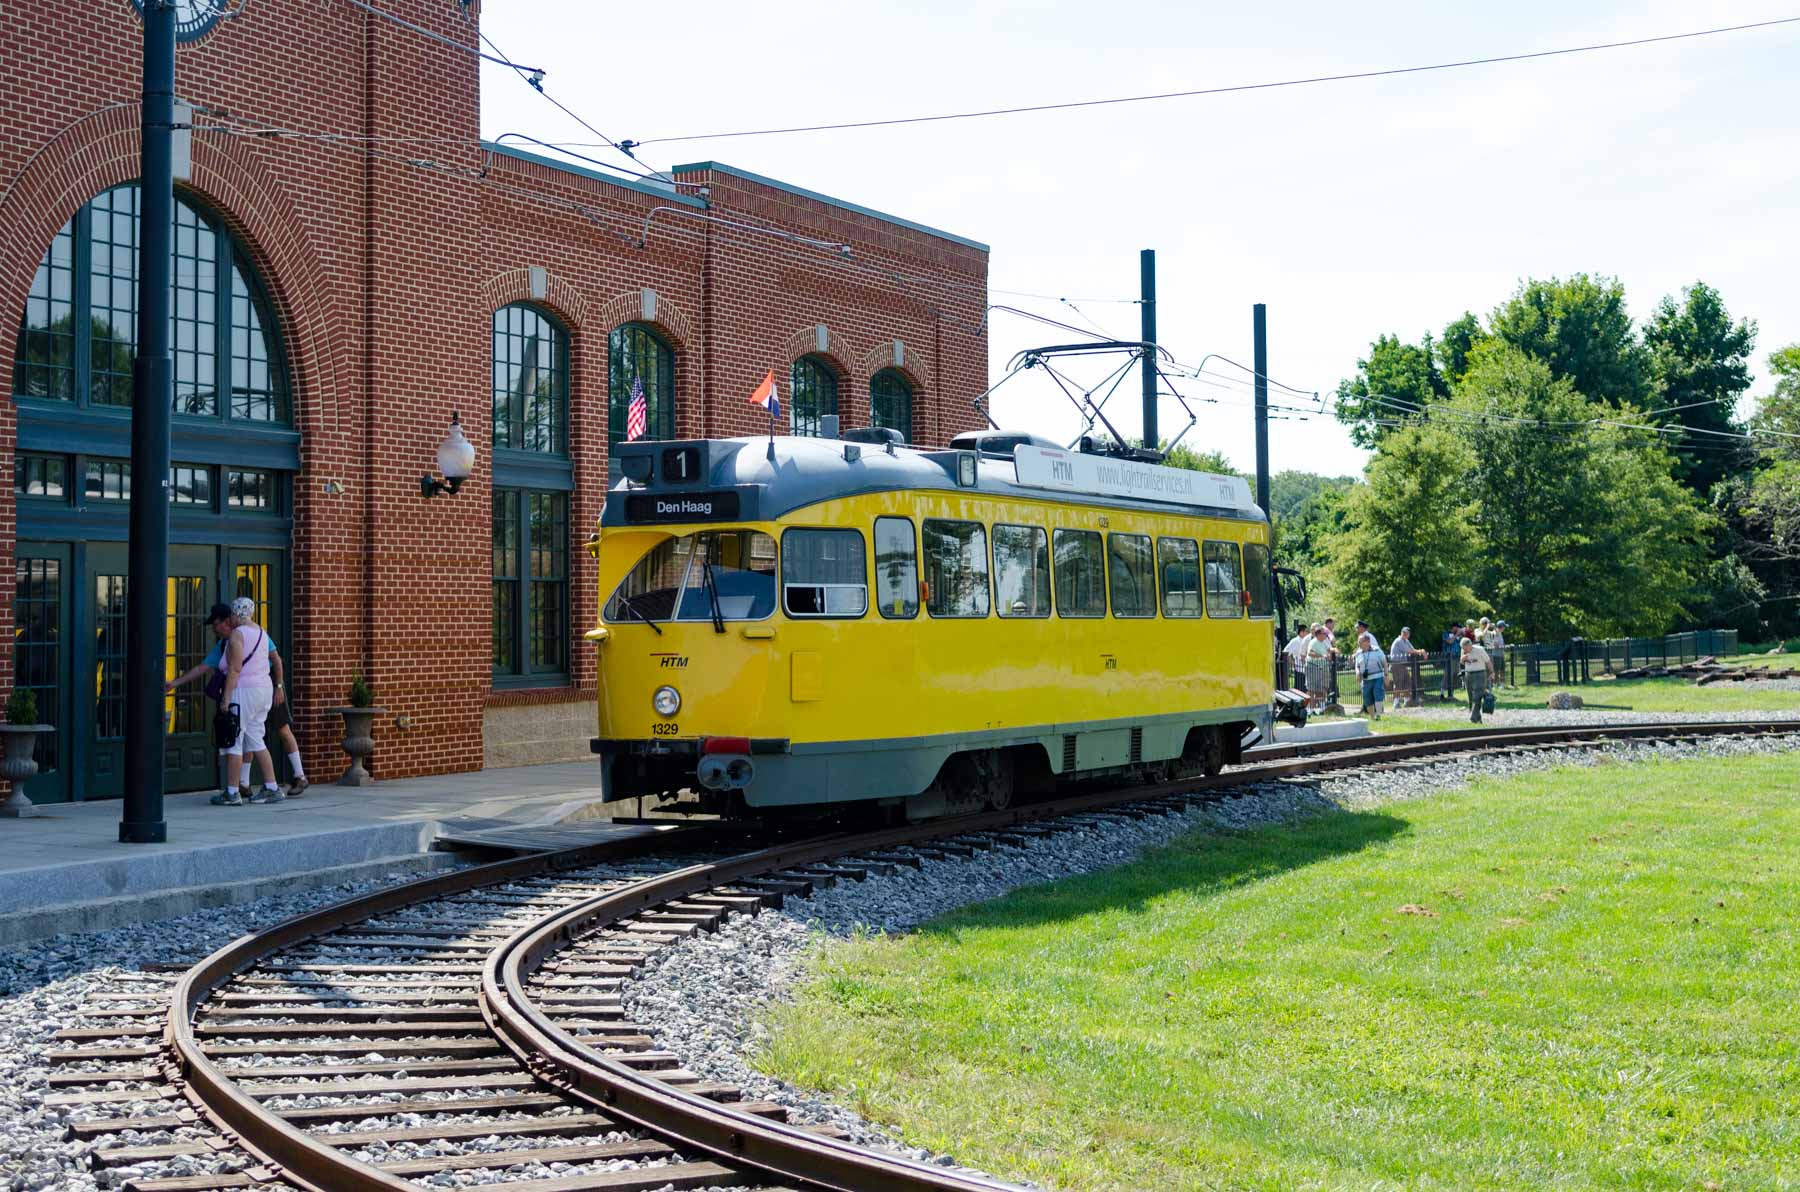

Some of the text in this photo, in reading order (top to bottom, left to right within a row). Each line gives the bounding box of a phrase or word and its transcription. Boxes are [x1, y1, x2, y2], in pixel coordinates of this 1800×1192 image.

[675, 451, 686, 477] 1
[1051, 459, 1073, 480] HTM
[1219, 484, 1235, 501] HTM
[657, 500, 712, 514] Den Haag
[660, 656, 689, 667] HTM
[1105, 658, 1117, 669] HTM
[651, 723, 679, 735] 1329
